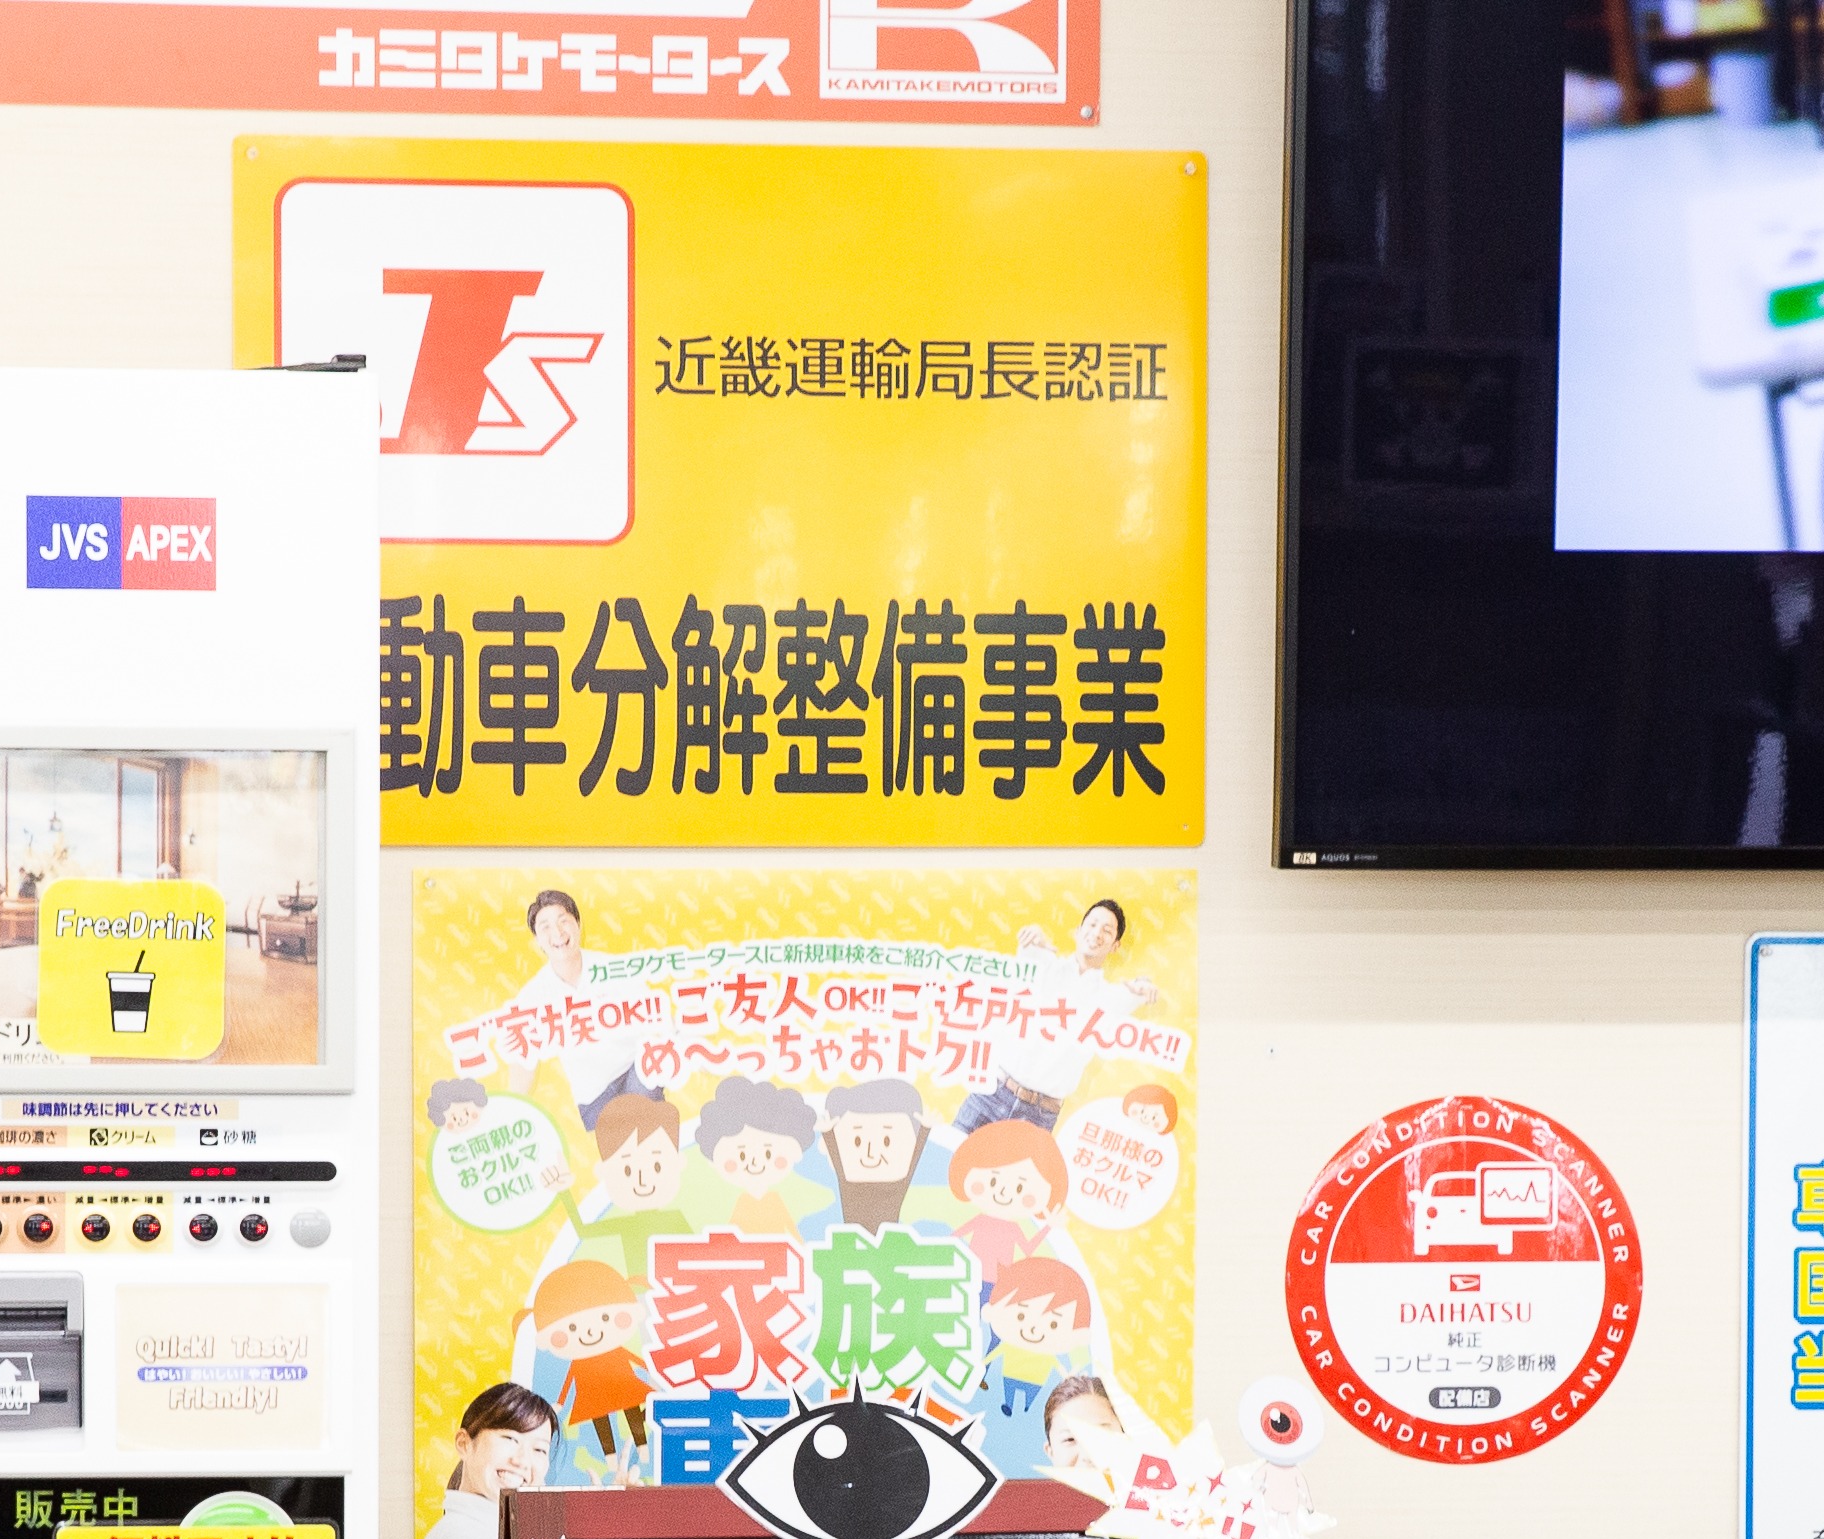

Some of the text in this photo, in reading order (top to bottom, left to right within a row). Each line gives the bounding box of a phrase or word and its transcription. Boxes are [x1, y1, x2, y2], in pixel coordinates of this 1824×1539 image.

[319, 26, 791, 96] カミタケモータース
[827, 78, 1058, 94] KAMITAKEMOTORS
[655, 336, 1168, 402] 近畿運輸局長認証
[40, 523, 212, 562] JVS APEX
[56, 909, 215, 942] FreeDrink
[22, 1101, 218, 1118] 味調節は先に押してください
[111, 1129, 157, 1145] クリーム
[224, 1129, 257, 1145] 砂糖
[448, 1117, 534, 1166] ご両親の
[1077, 1120, 1164, 1170] 旦那様の
[457, 1145, 540, 1191] おクルマ
[1072, 1145, 1153, 1193] おクルマ
[1300, 1110, 1629, 1266] CAR CONDITION SCANNER
[647, 1230, 976, 1393] 家族
[1399, 1302, 1532, 1324] DAIHATSU
[1447, 1332, 1482, 1349] 純正
[1300, 1303, 1629, 1455] CAR CONDITION SCANNER
[1374, 1353, 1557, 1374] コンピュータ診断機
[14, 1488, 138, 1528] 販売中
